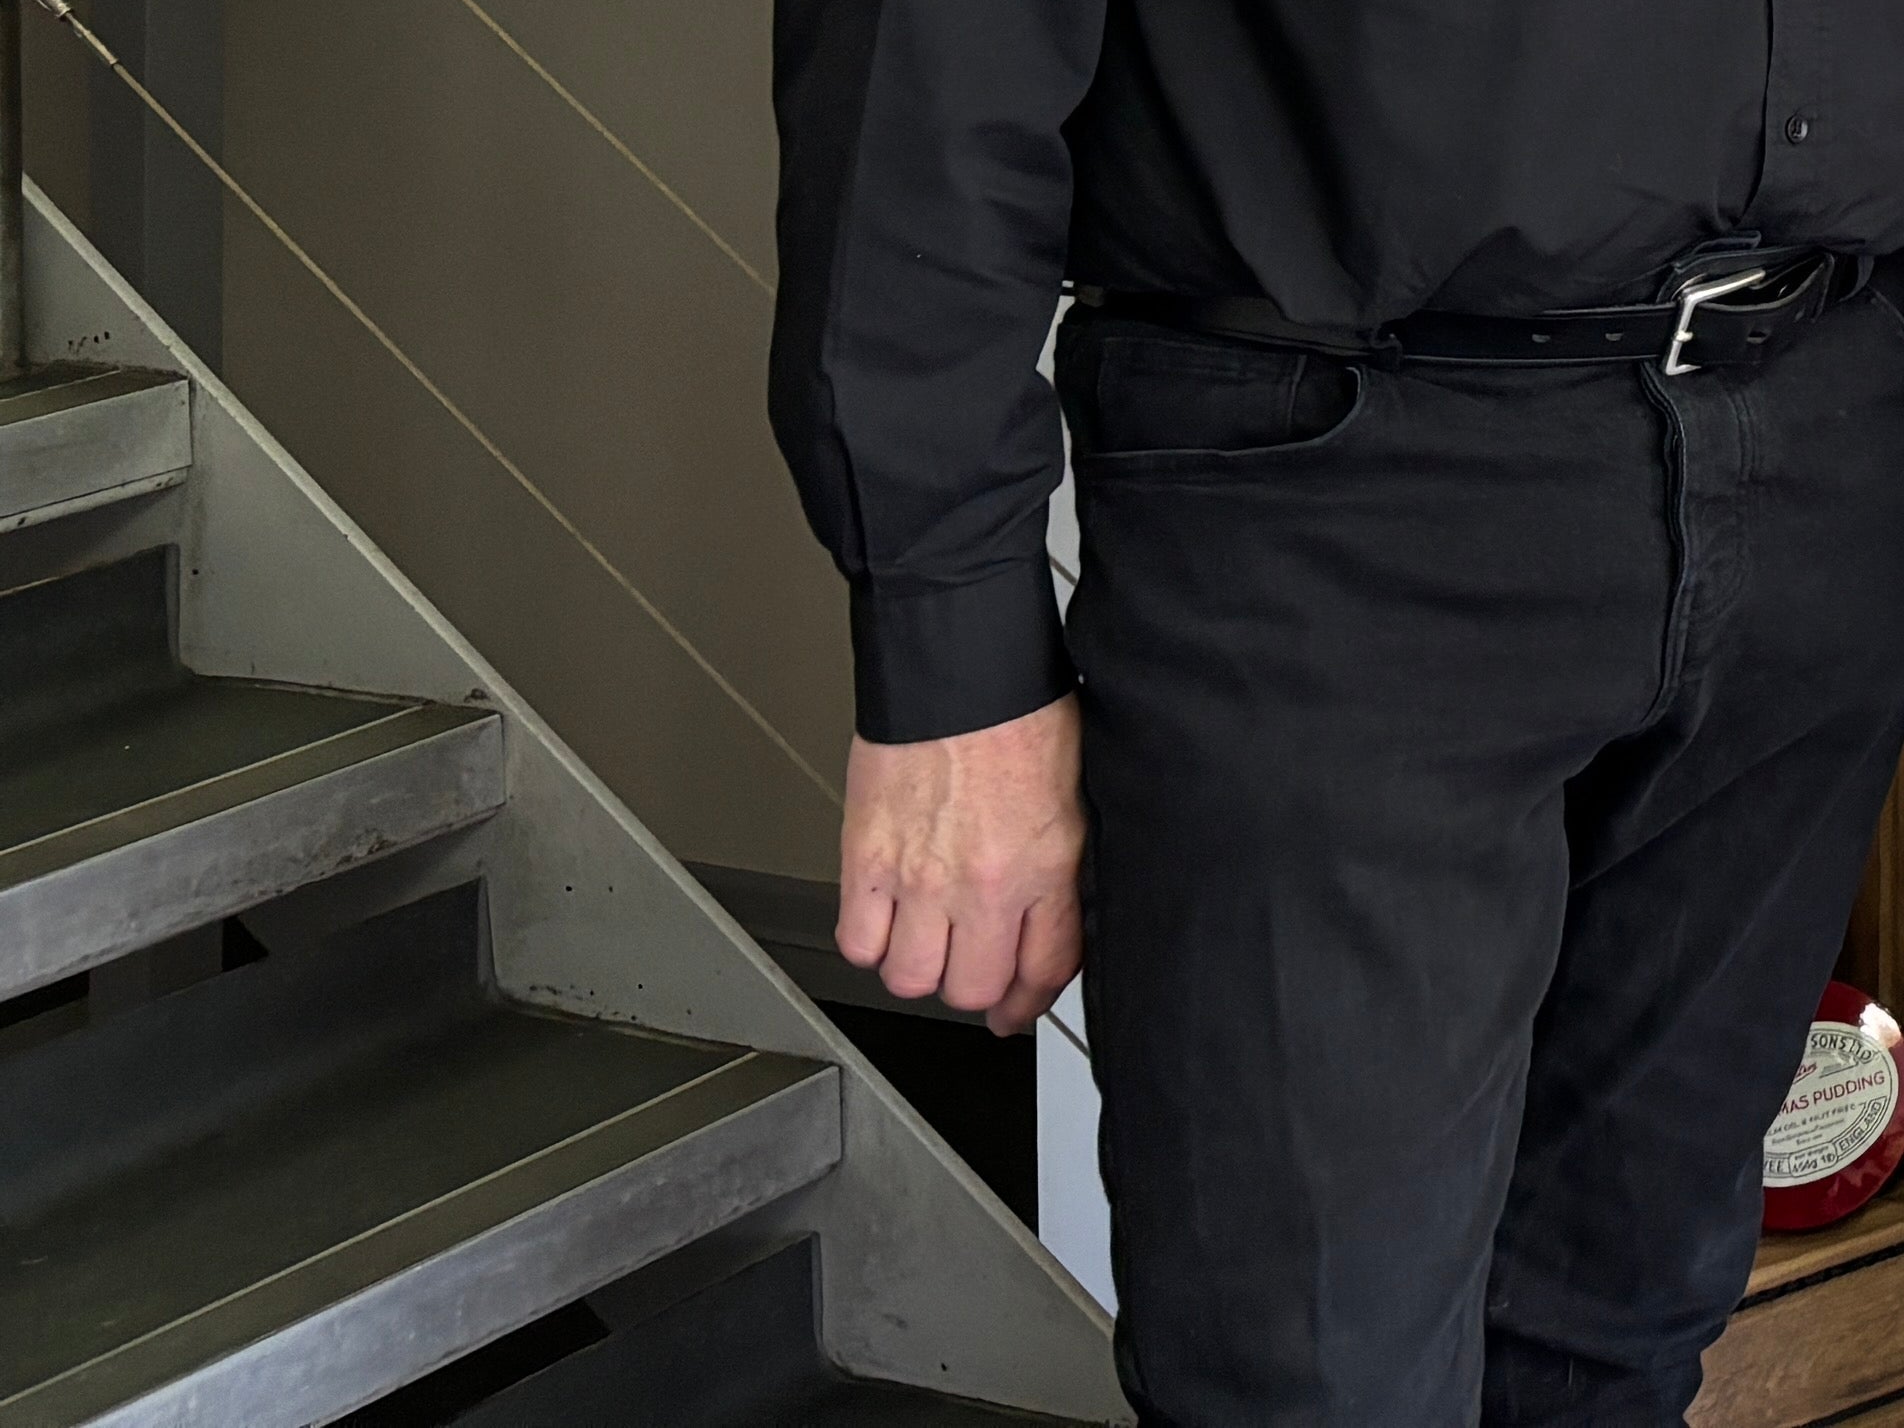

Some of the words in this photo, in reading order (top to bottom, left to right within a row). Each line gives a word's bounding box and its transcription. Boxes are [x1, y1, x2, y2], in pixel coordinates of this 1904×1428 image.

[1810, 1033, 1847, 1053] SONS
[1813, 1070, 1886, 1105] PUDDING
[1838, 1100, 1883, 1153] ENGLAND
